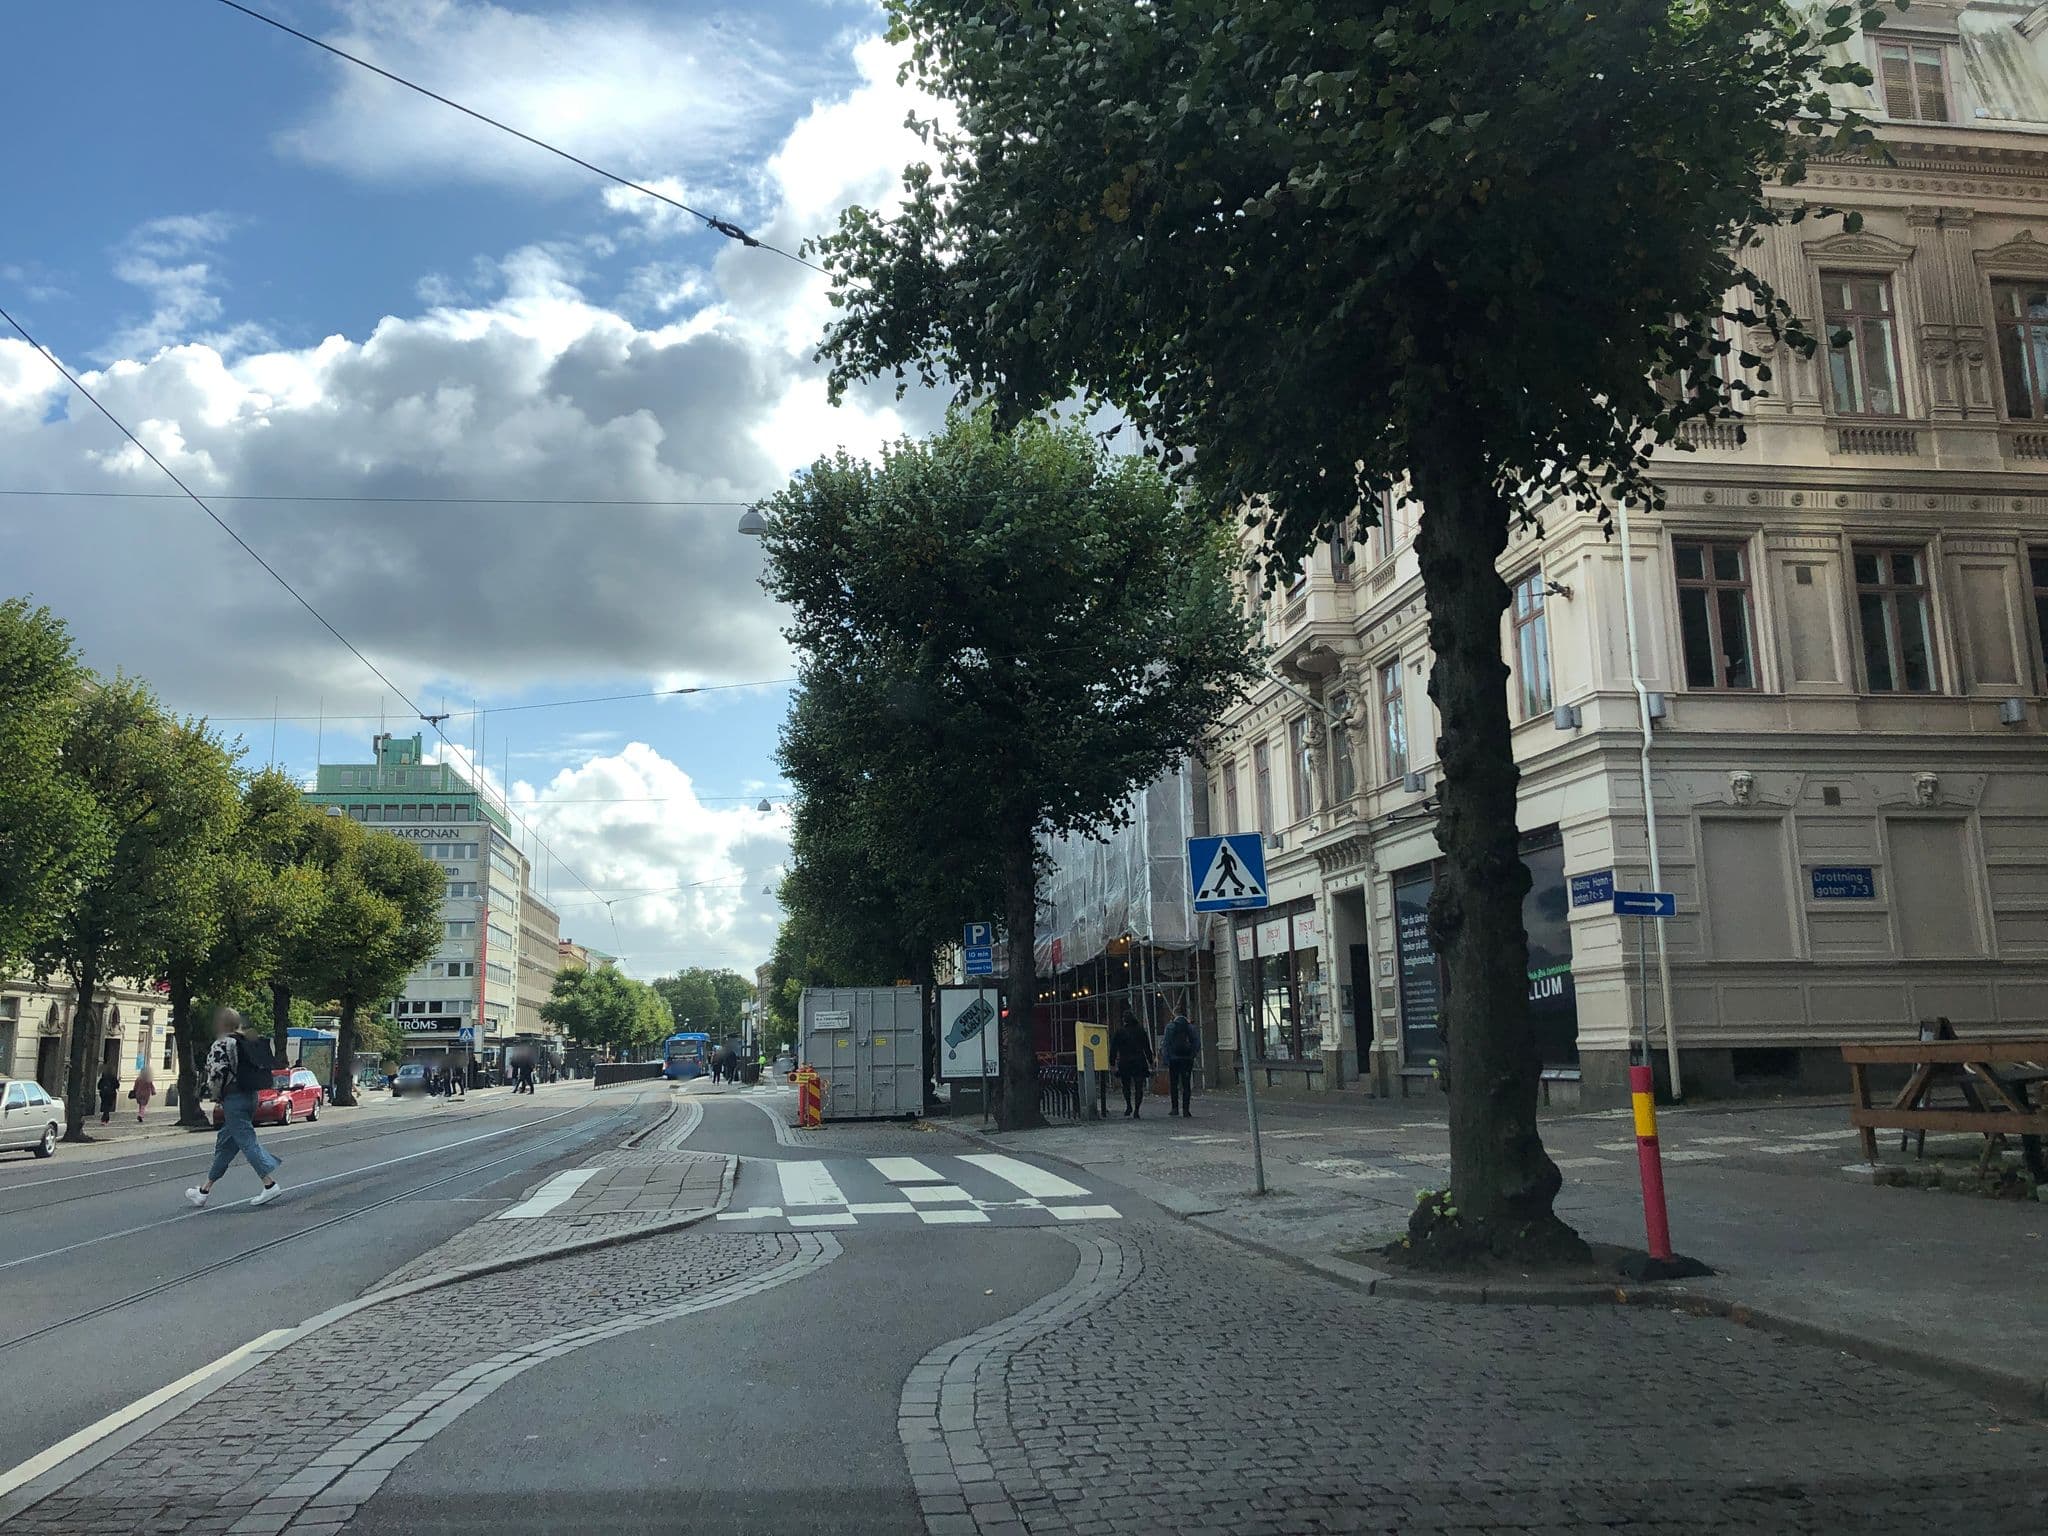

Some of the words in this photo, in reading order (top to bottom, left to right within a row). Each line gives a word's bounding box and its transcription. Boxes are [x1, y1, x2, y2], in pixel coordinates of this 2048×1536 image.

[375, 828, 459, 839] VSAKRONAN
[972, 925, 985, 945] P
[398, 1018, 438, 1030] TRÖMS
